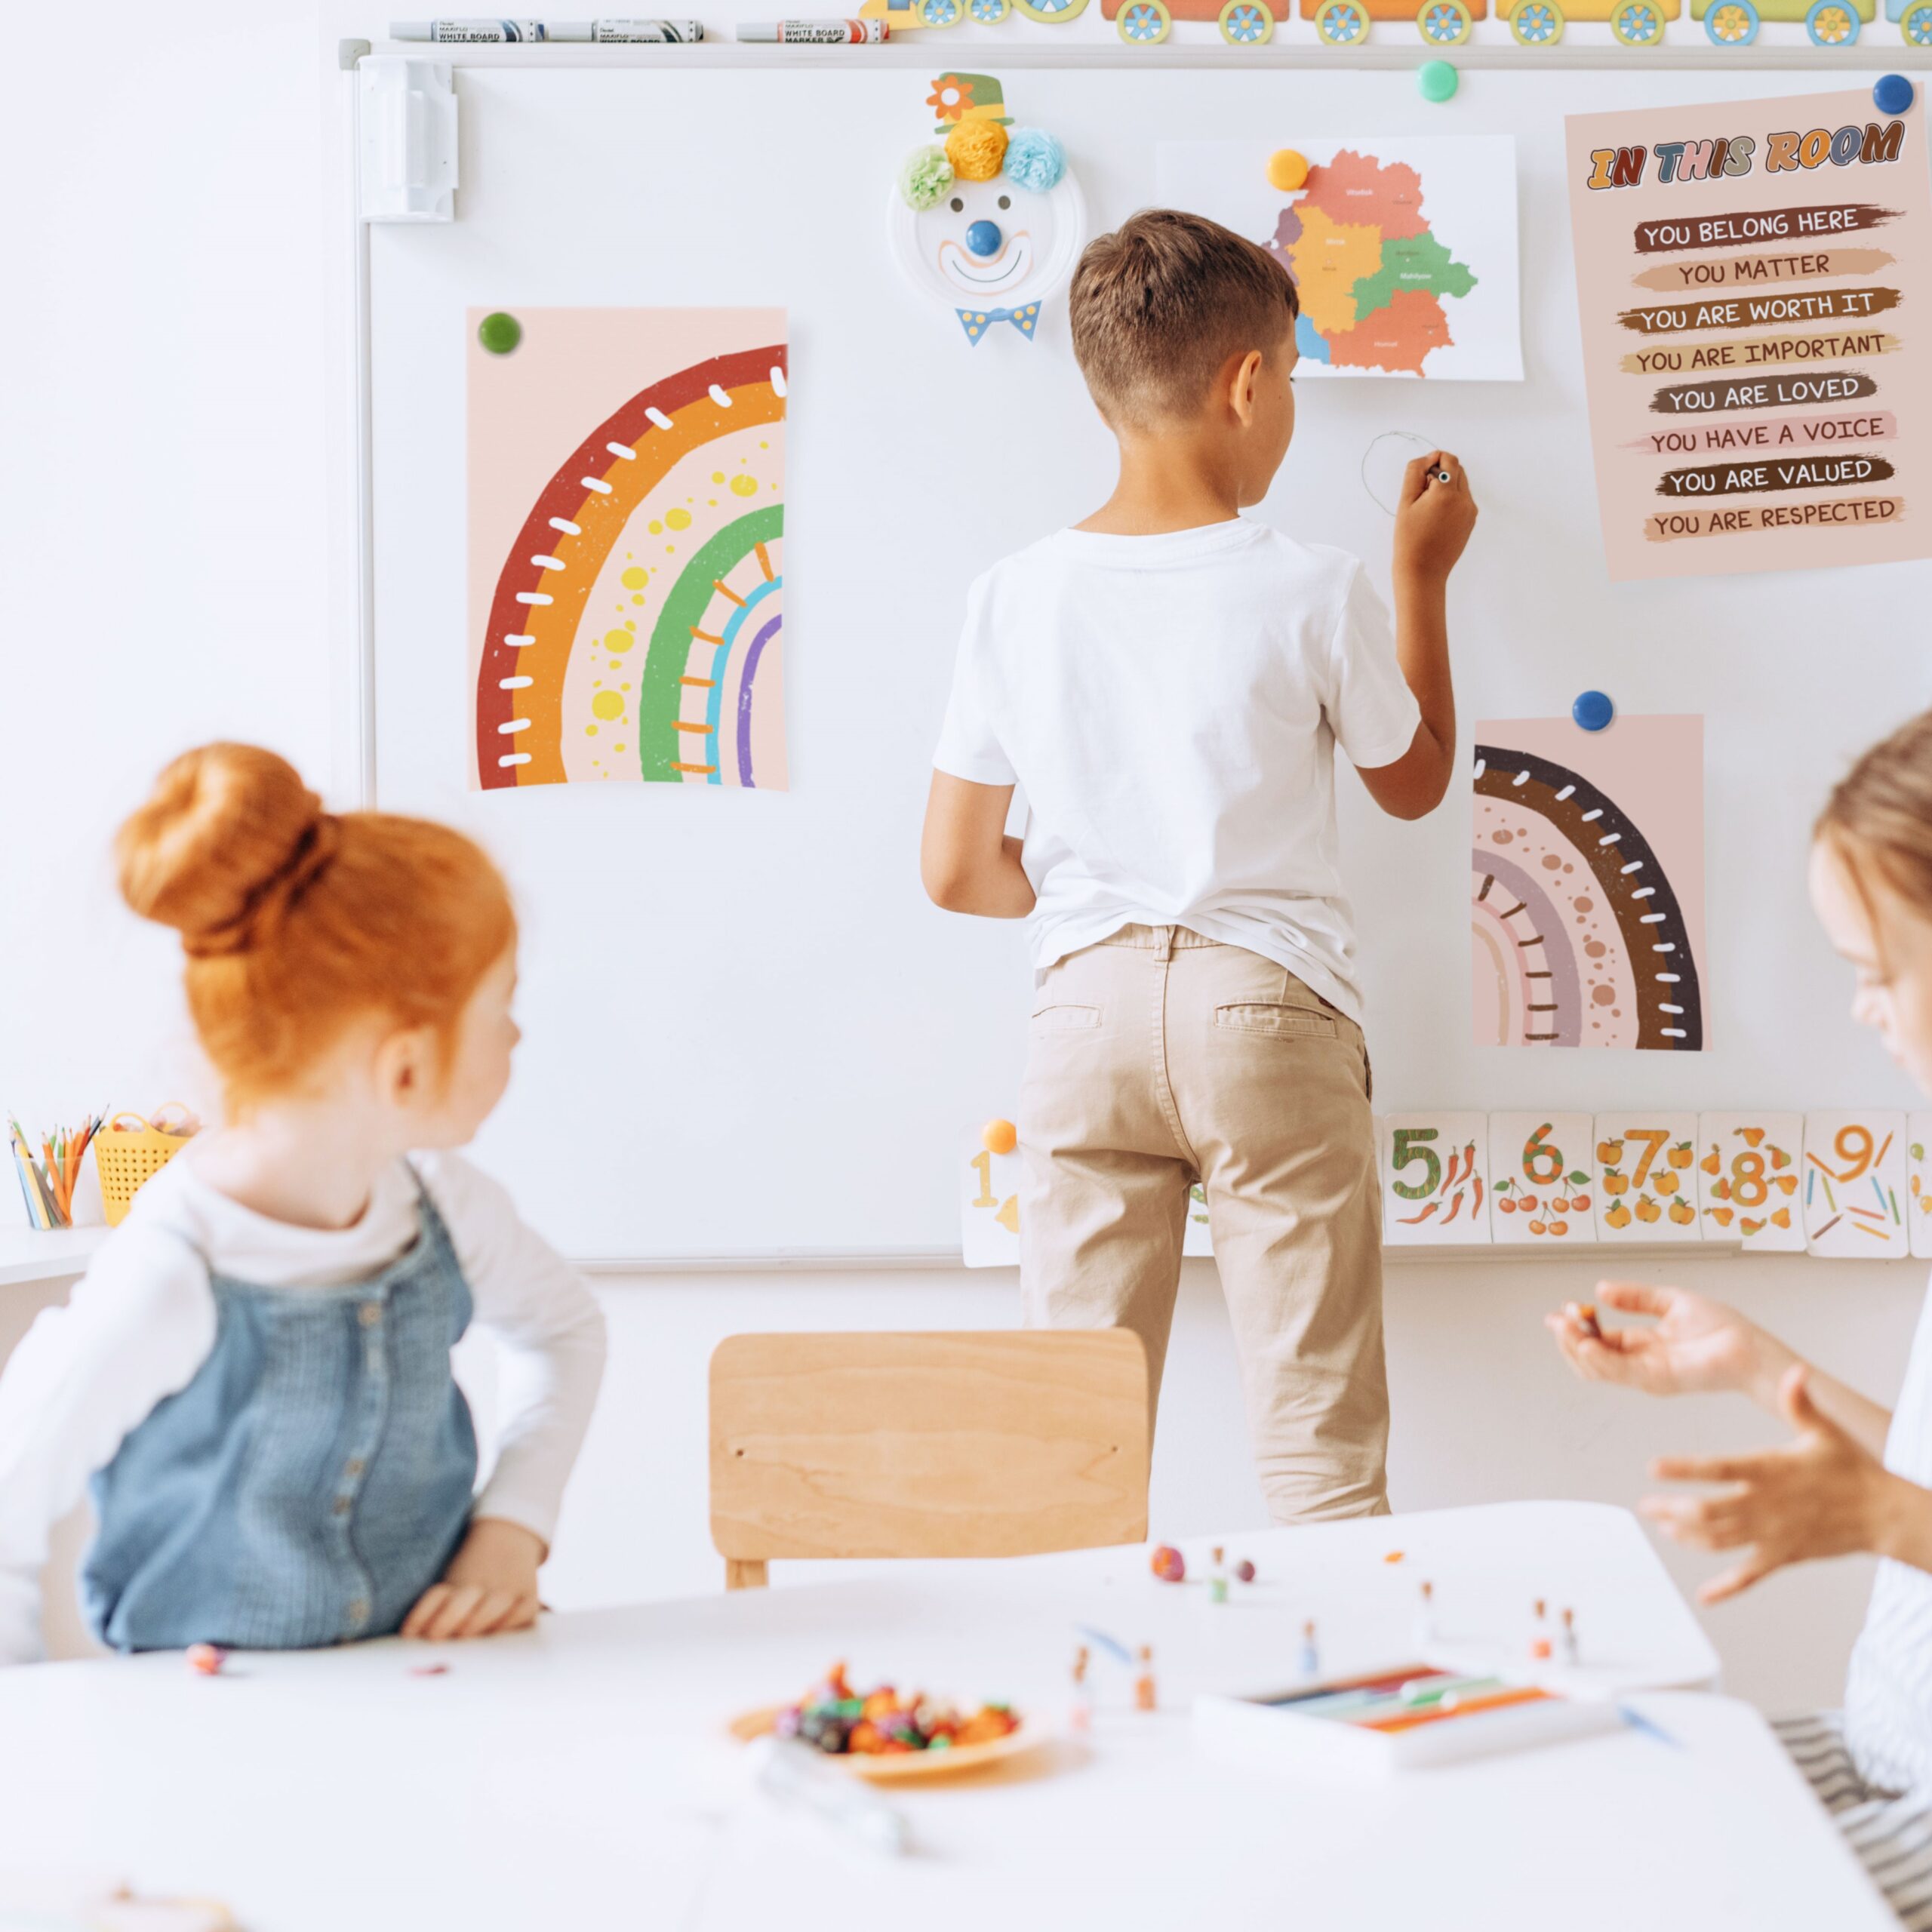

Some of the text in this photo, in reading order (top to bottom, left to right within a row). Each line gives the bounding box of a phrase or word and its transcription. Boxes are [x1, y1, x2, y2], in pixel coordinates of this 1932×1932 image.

[1587, 121, 1905, 189] IN THIS ROOM
[1644, 208, 1859, 247] YOU BELONG HERE
[1679, 254, 1829, 285] YOU MATTER
[1641, 293, 1874, 330] YOU ARE WORTH IT
[1637, 334, 1885, 371] YOU ARE IMPORTANT
[1669, 377, 1859, 410] YOU ARE LOVED
[1651, 417, 1884, 452] YOU HAVE A VOICE
[1669, 460, 1872, 492] YOU ARE VALUED
[1654, 500, 1895, 534] YOU ARE RESPECTED
[1392, 1128, 1441, 1199] 5
[1522, 1122, 1563, 1185] 6
[1623, 1128, 1670, 1189] 7
[1833, 1124, 1875, 1183] 9
[971, 1150, 998, 1208] 1
[1730, 1152, 1768, 1207] 8
